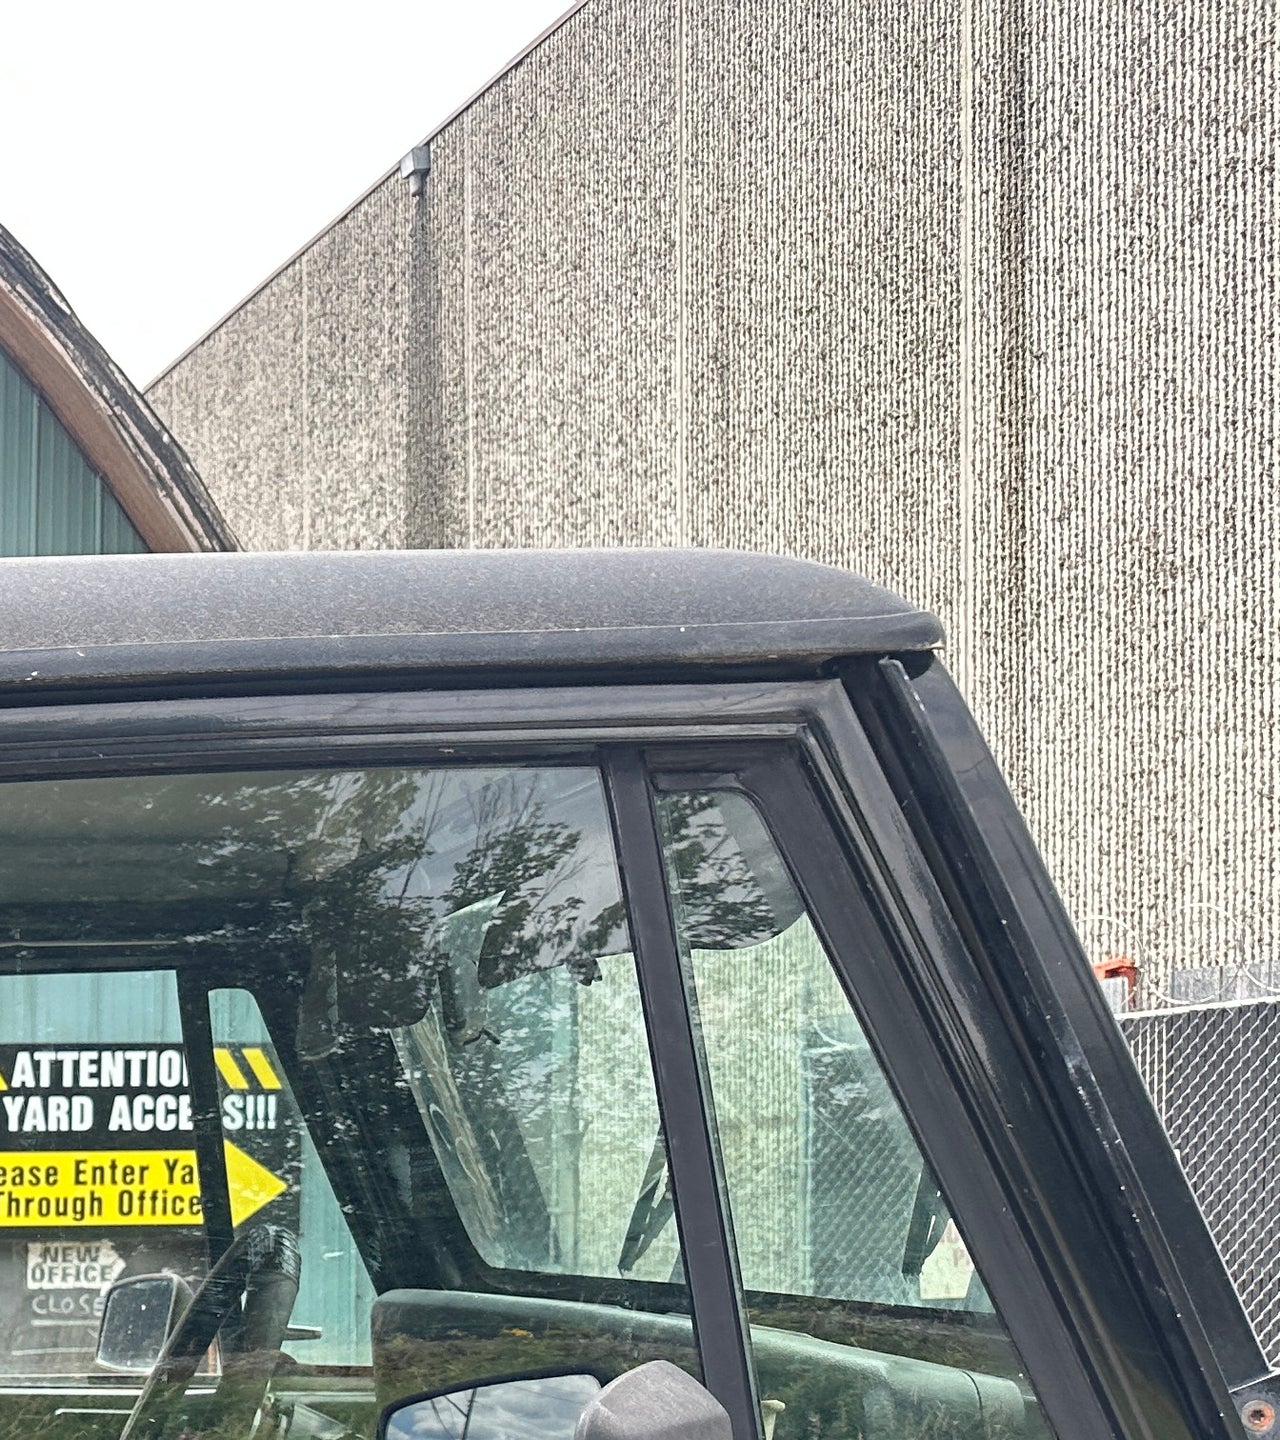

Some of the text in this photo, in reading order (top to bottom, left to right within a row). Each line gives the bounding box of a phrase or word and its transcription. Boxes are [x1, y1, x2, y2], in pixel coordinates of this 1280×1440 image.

[11, 1049, 190, 1088] ATTENTIO
[3, 1095, 93, 1132] YARD
[109, 1094, 277, 1131] ACCES!!!
[74, 1160, 149, 1186] Enter
[165, 1159, 194, 1185] Ya
[118, 1189, 201, 1216] Office
[43, 1247, 100, 1263] NEW
[31, 1265, 113, 1283] OFFICE
[32, 1294, 104, 1316] CLOSE
